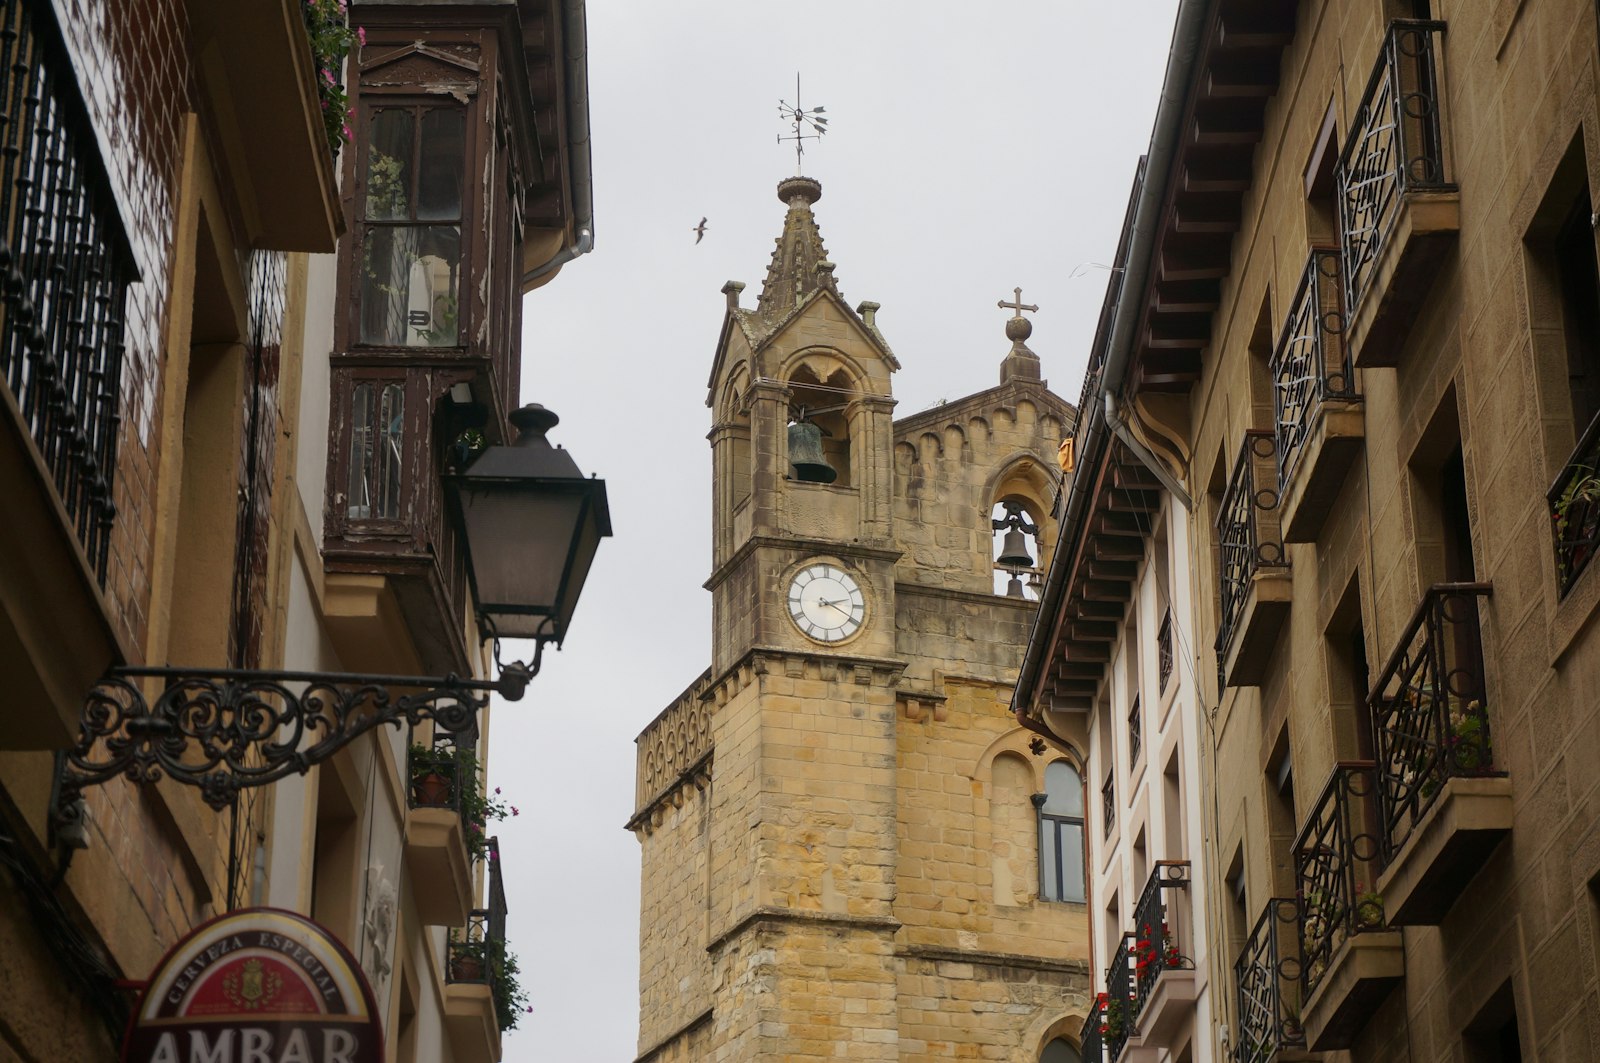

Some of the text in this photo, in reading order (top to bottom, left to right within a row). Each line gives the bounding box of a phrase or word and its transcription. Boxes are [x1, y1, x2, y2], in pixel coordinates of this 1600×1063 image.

[168, 934, 336, 1004] CERVEZA ESPECIAL
[149, 1027, 359, 1063] AMBAR
